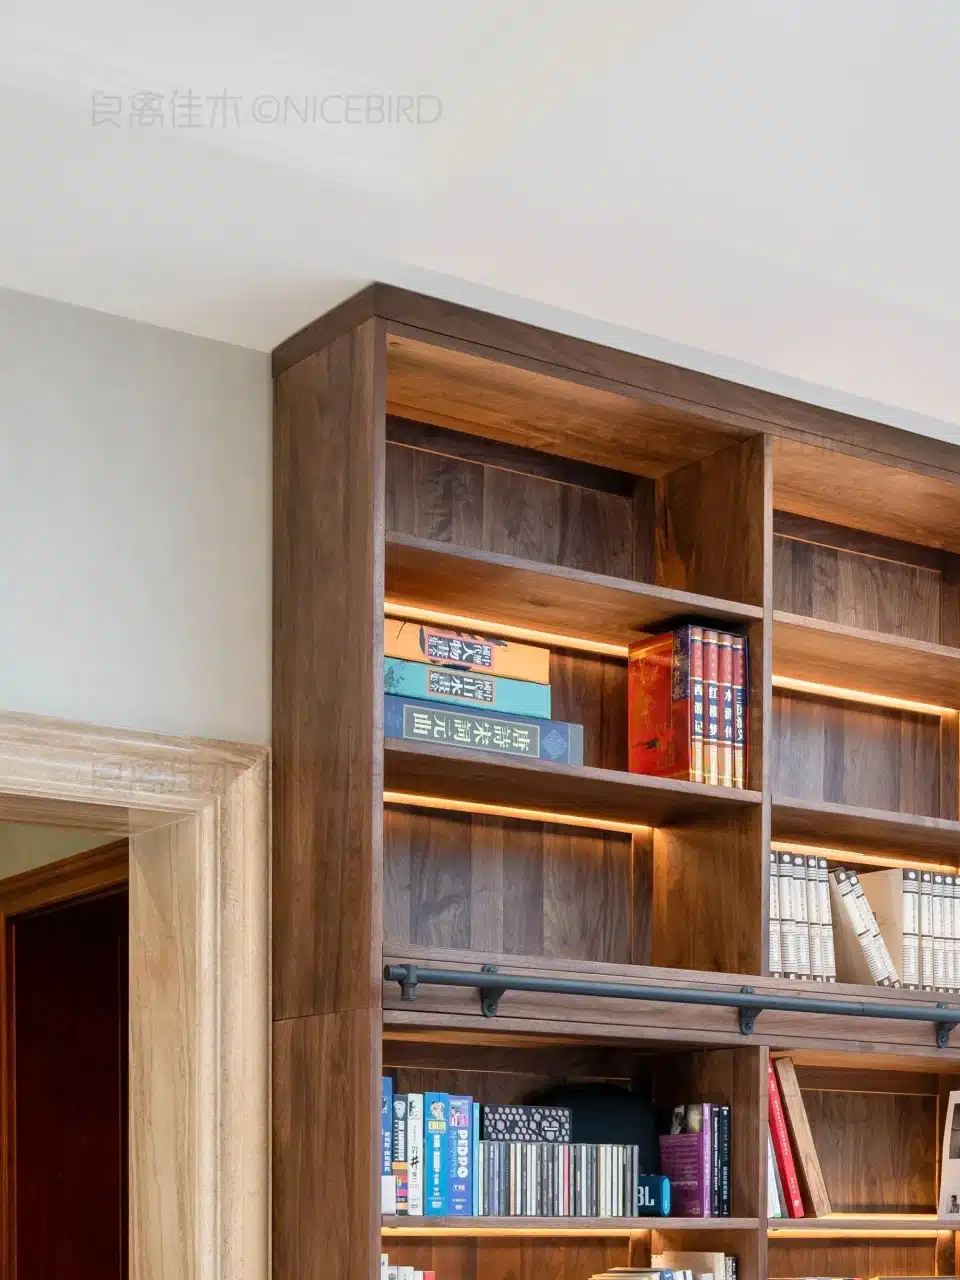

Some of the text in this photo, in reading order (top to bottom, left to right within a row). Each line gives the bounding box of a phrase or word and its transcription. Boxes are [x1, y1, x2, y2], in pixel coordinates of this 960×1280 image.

[412, 711, 533, 753] 唐詩宋詞元曲
[637, 1186, 655, 1206] BL
